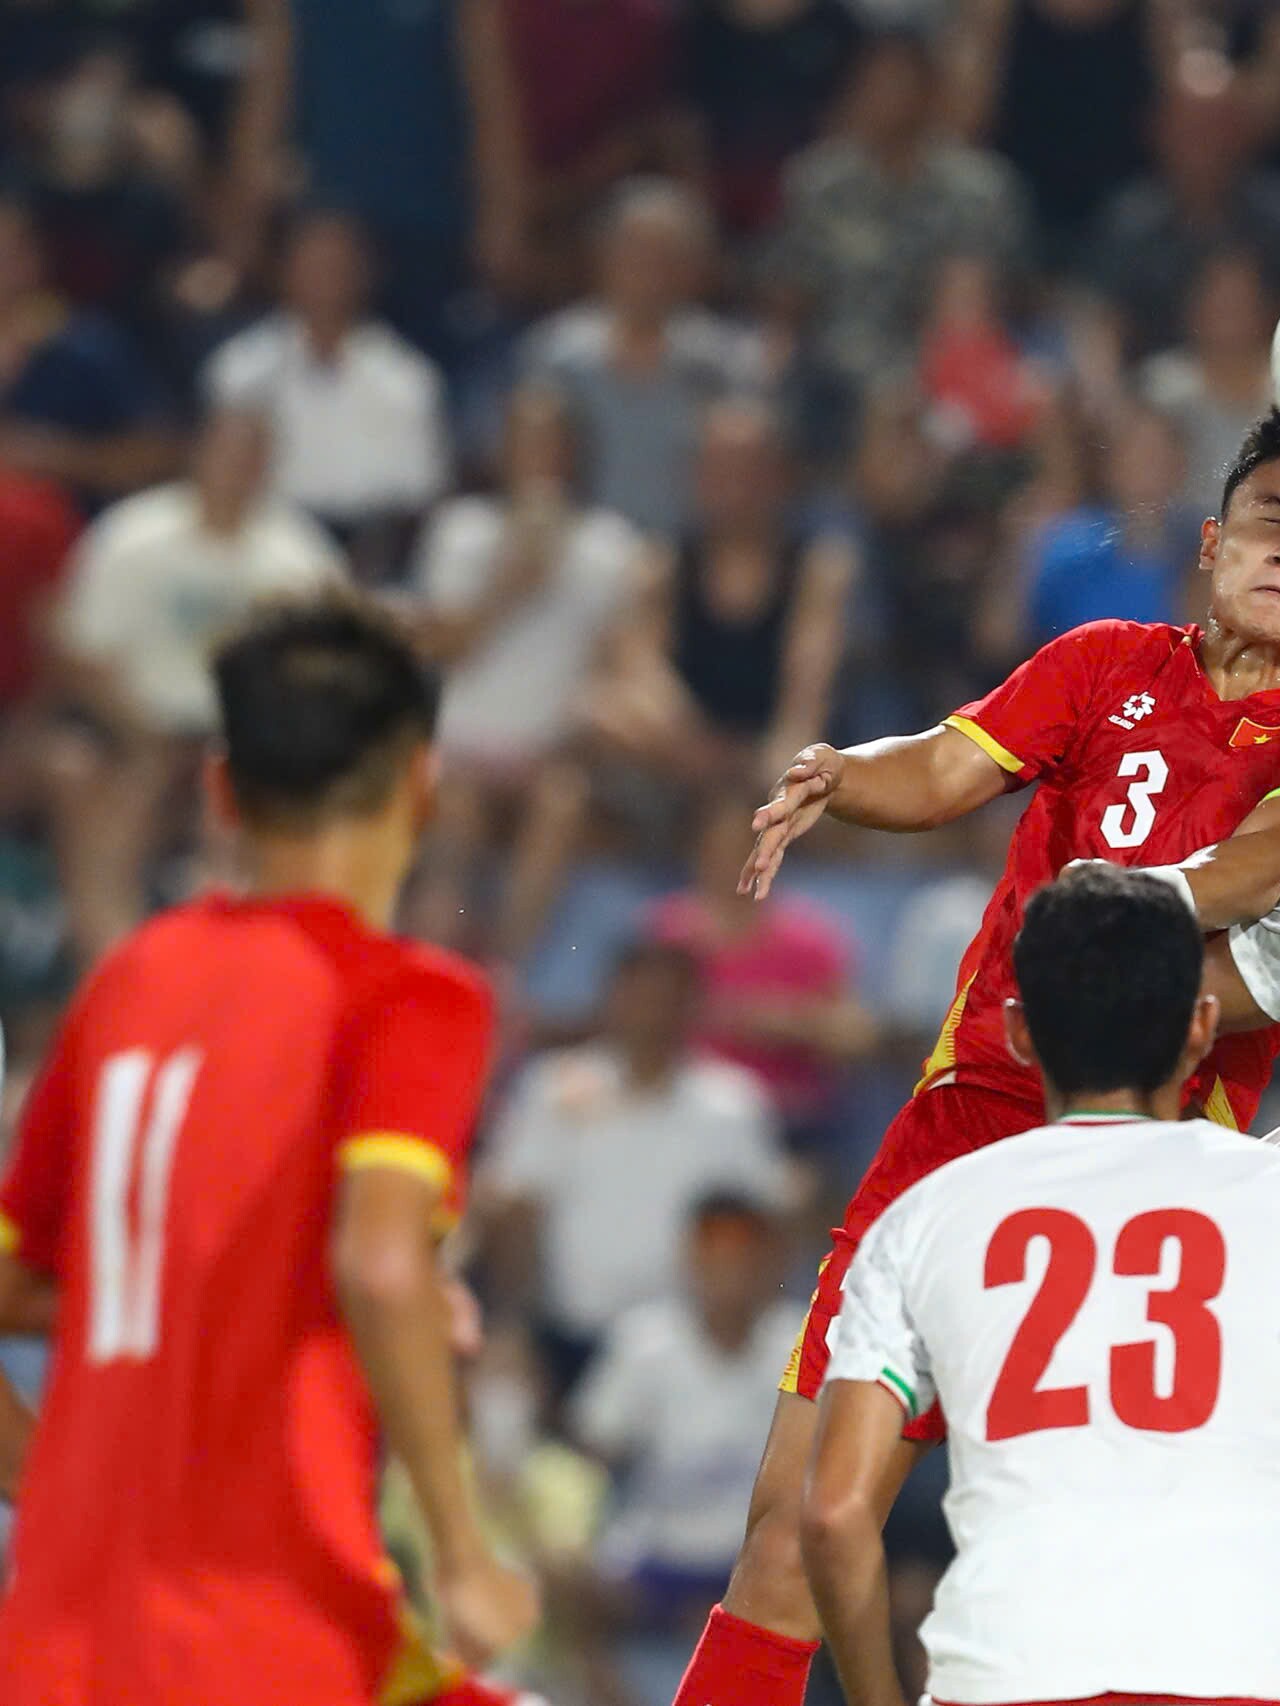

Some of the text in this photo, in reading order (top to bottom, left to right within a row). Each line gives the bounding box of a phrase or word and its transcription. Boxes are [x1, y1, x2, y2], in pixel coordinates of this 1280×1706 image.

[1100, 750, 1169, 848] 3
[86, 1046, 204, 1364] 11
[983, 1206, 1227, 1442] 23
